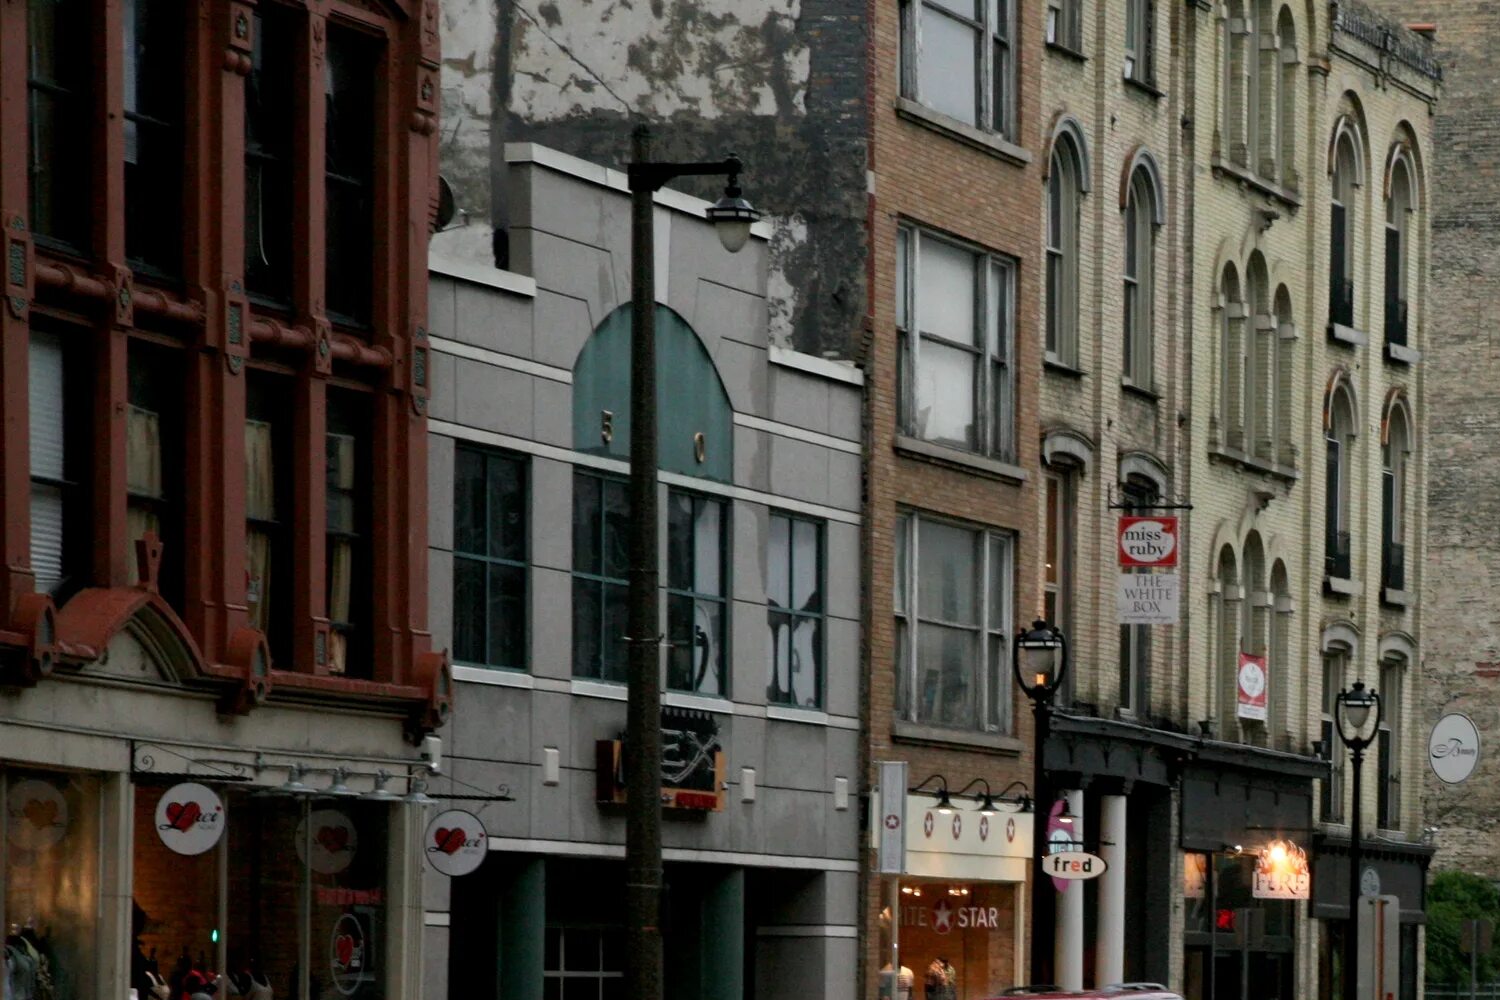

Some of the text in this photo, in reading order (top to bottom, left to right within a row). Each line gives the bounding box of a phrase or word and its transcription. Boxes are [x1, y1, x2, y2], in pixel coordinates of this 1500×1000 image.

[1125, 526, 1161, 540] miss
[1129, 541, 1165, 560] ruby
[1134, 575, 1162, 587] THE
[1124, 588, 1171, 600] WHITE
[1133, 600, 1161, 612] BOX
[1053, 857, 1091, 872] fred
[958, 907, 998, 928] STAR
